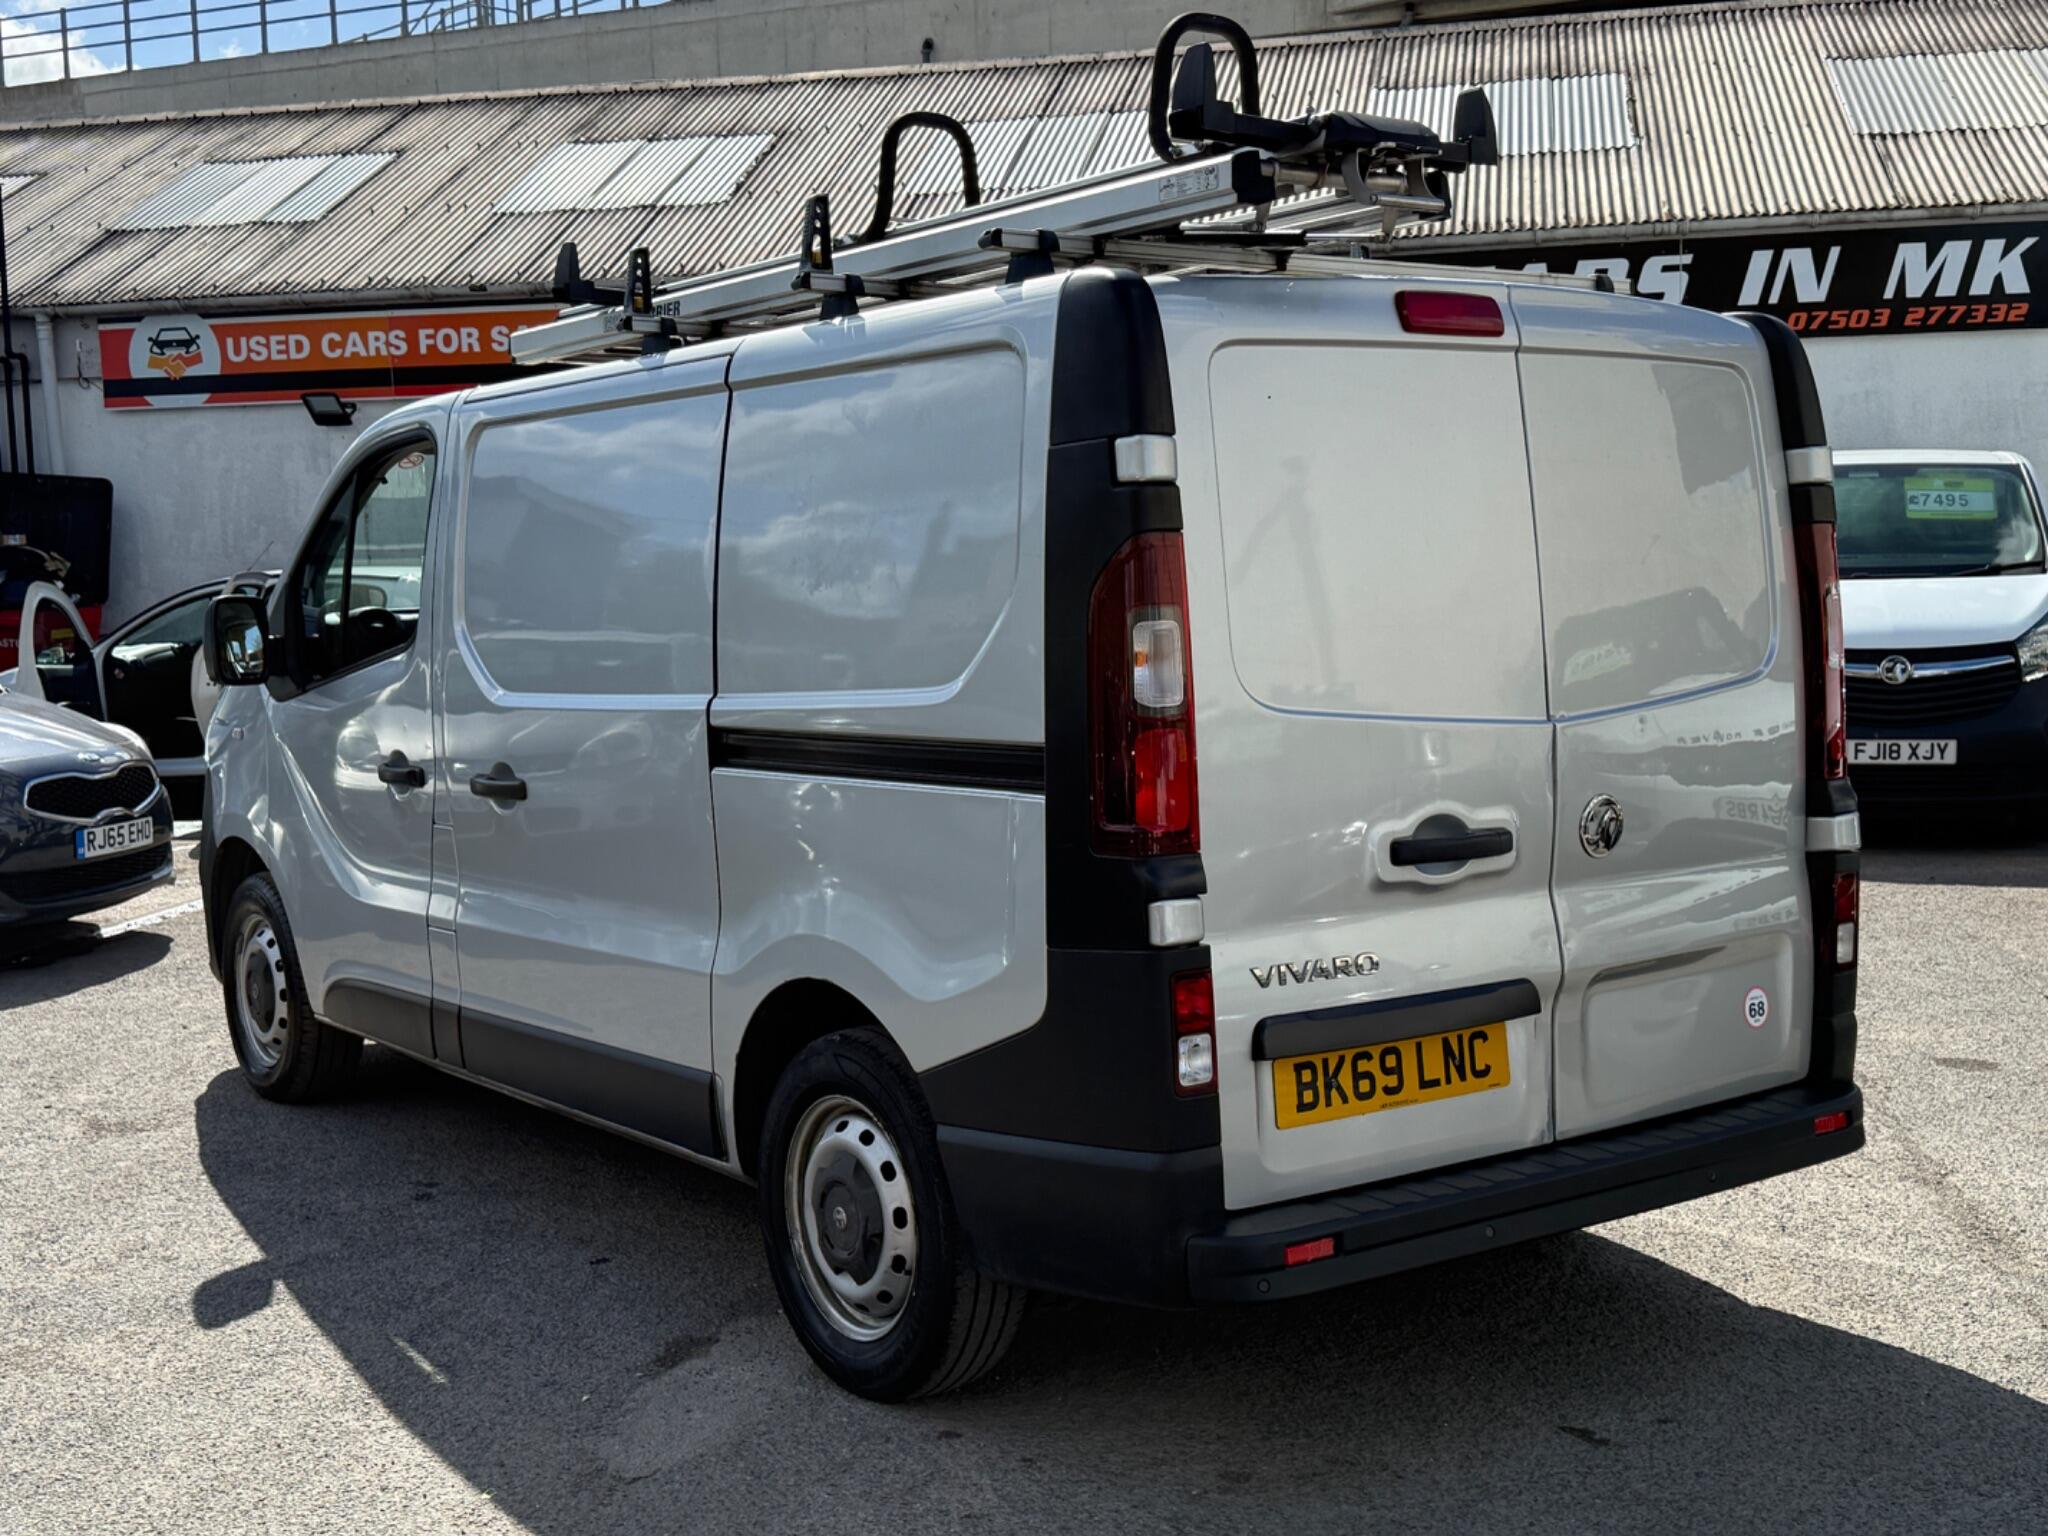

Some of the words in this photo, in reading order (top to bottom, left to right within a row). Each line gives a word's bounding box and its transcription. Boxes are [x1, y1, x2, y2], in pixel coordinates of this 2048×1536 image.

[1737, 246, 1841, 306] IN
[1883, 236, 2040, 299] MK
[1787, 308, 1891, 331] 07503
[1904, 302, 2030, 327] 277332
[226, 334, 310, 363] USED
[321, 329, 408, 358] CARS
[418, 326, 481, 355] FOR
[1854, 742, 1901, 760] FJ18
[1908, 742, 1949, 760] XJY
[86, 825, 126, 852] RJ65
[1249, 951, 1380, 989] VIVARO
[1749, 1000, 1765, 1018] 68
[1293, 1045, 1405, 1114] BK69
[1415, 1030, 1492, 1091] LNC
